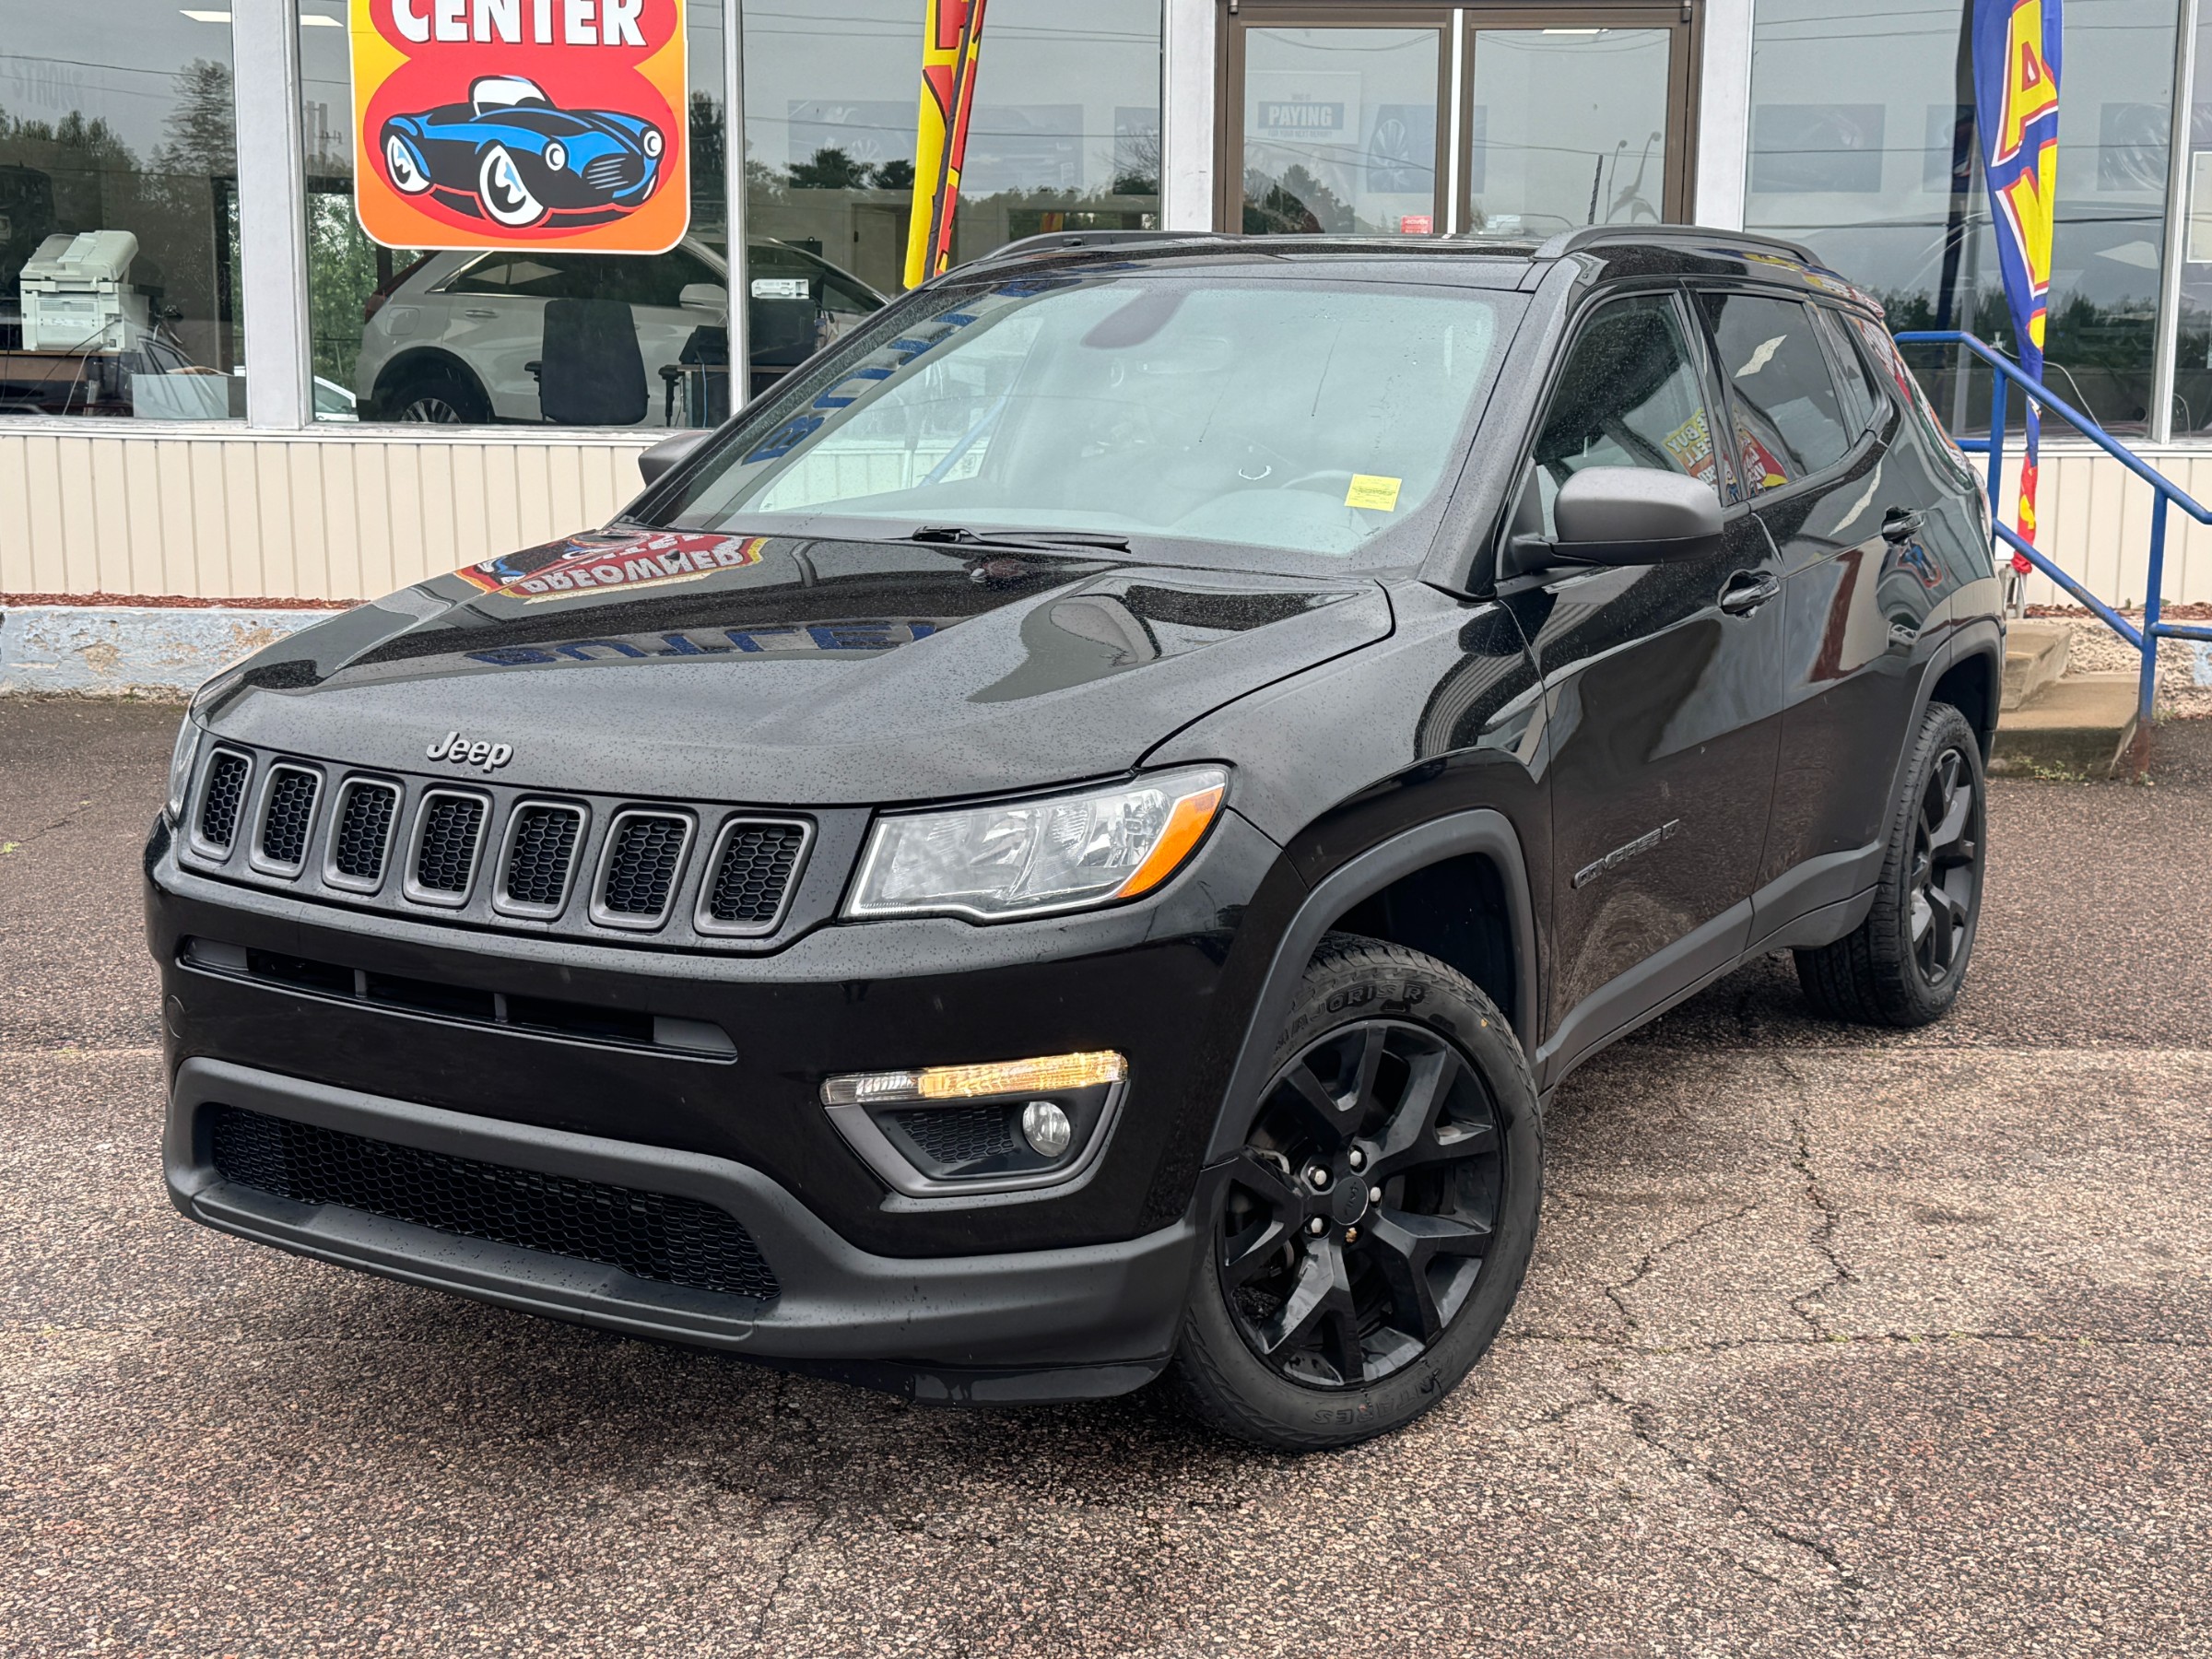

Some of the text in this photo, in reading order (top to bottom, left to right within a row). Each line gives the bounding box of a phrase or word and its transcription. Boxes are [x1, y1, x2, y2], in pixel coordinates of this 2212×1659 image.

[392, 0, 648, 46] CENTER
[1269, 105, 1333, 127] PAYING
[426, 731, 514, 774] Jeep
